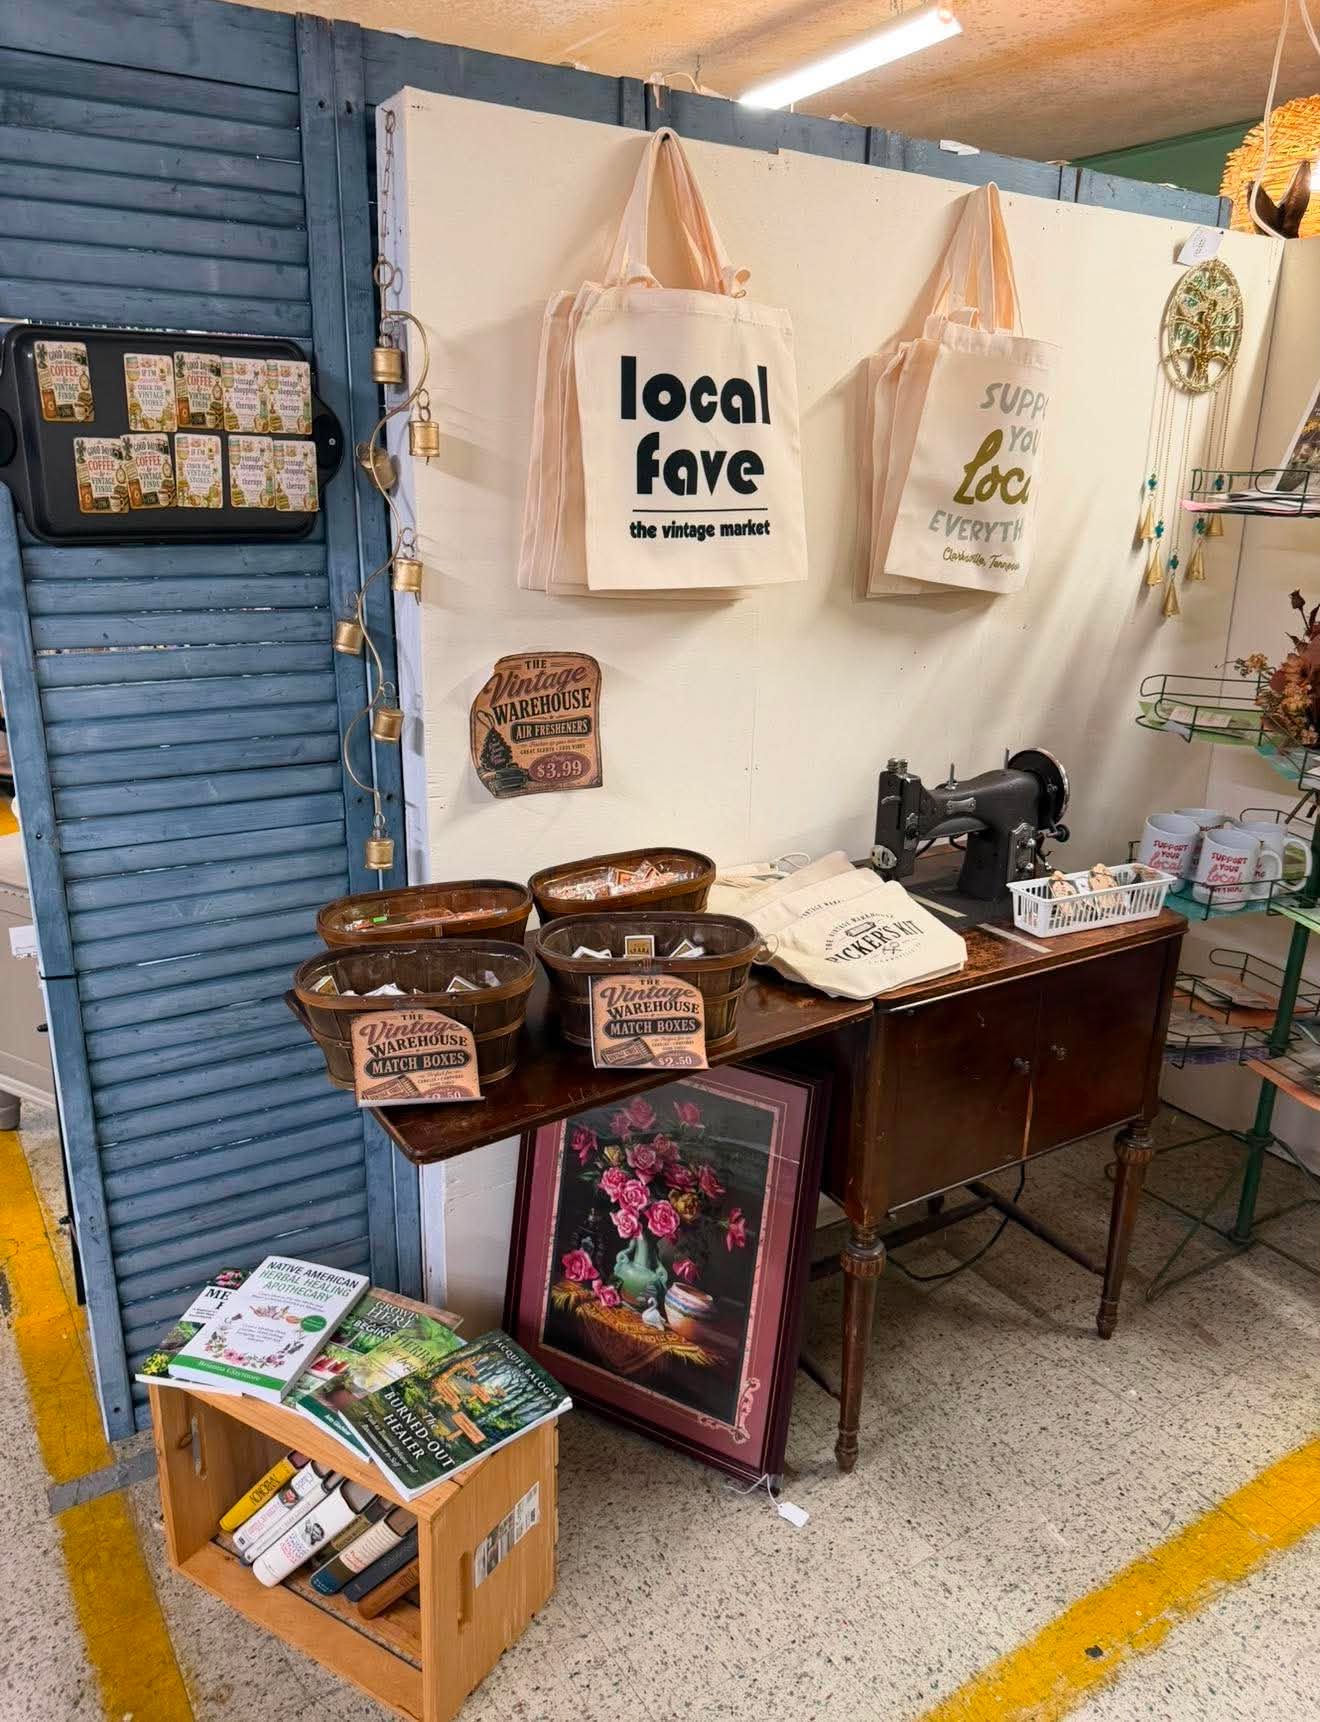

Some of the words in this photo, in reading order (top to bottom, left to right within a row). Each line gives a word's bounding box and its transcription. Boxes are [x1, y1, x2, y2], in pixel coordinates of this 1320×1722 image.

[50, 365, 79, 377] COFFEE
[621, 356, 771, 424] local
[87, 460, 115, 472] COFFEE
[135, 455, 161, 466] COFFEE
[637, 432, 764, 496] fave
[630, 521, 657, 539] the
[662, 520, 715, 541] vintage
[720, 519, 770, 537] market
[525, 660, 547, 669] THE
[484, 666, 585, 706] Vintage
[493, 688, 591, 726] WAREHOUSE
[516, 727, 532, 740] AIR
[535, 720, 588, 736] FRESHENERS
[537, 760, 582, 778] $3.99
[1153, 840, 1188, 851] SUPPORT
[1161, 851, 1180, 859] YOUR
[1211, 852, 1248, 864] SUPPORT
[1220, 864, 1239, 872] YOUR
[824, 925, 900, 962] PICKER'S
[893, 920, 924, 936] KIT
[600, 985, 697, 1008] Vintage
[401, 1013, 424, 1021] THE
[607, 1000, 700, 1020] WAREHOUSE
[360, 1021, 465, 1046] Vintage
[610, 1021, 652, 1036] MATCH
[657, 1019, 696, 1034] BOXES
[367, 1034, 468, 1059] WAREHOUSE
[372, 1057, 417, 1075] MATCH
[424, 1052, 465, 1069] BOXES
[658, 1055, 692, 1067] $2.50
[259, 1270, 300, 1286] HERBAL
[303, 1280, 350, 1298] HEALING
[267, 1261, 303, 1275] NATIVE
[303, 1269, 359, 1289] AMERICAN
[264, 1281, 333, 1302] APOTHECARY
[492, 1339, 526, 1368] JACQUIE
[525, 1368, 558, 1400] BALOGH
[384, 1391, 455, 1467] BURNED-OUT
[422, 1412, 439, 1430] The
[384, 1413, 425, 1459] HEALER
